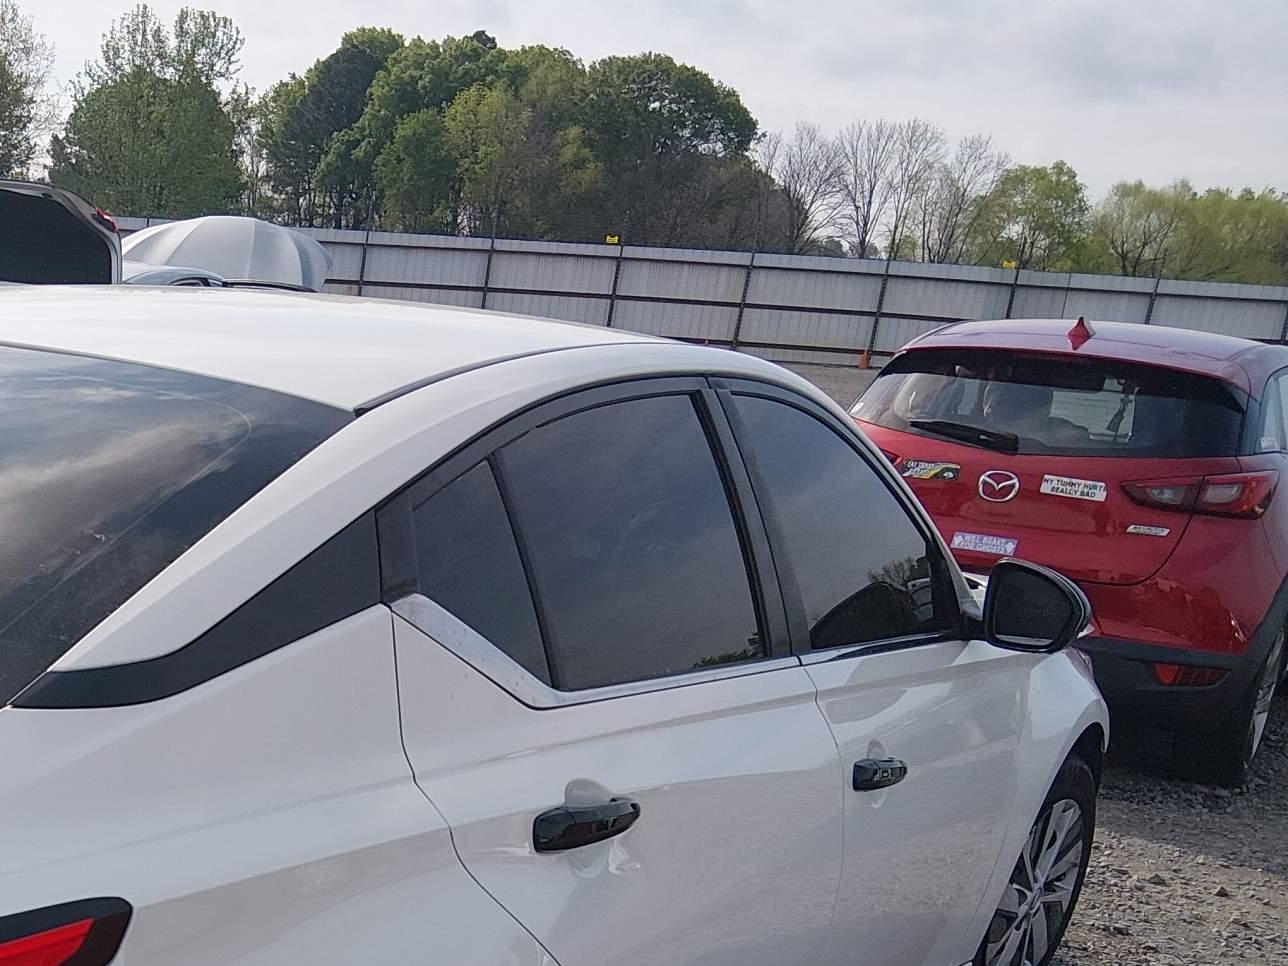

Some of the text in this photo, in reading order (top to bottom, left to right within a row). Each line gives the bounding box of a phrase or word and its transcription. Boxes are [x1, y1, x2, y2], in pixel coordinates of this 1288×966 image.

[1056, 479, 1082, 489] TUMMY
[1050, 486, 1096, 498] REALLY BAD
[982, 536, 1006, 546] BRAKE
